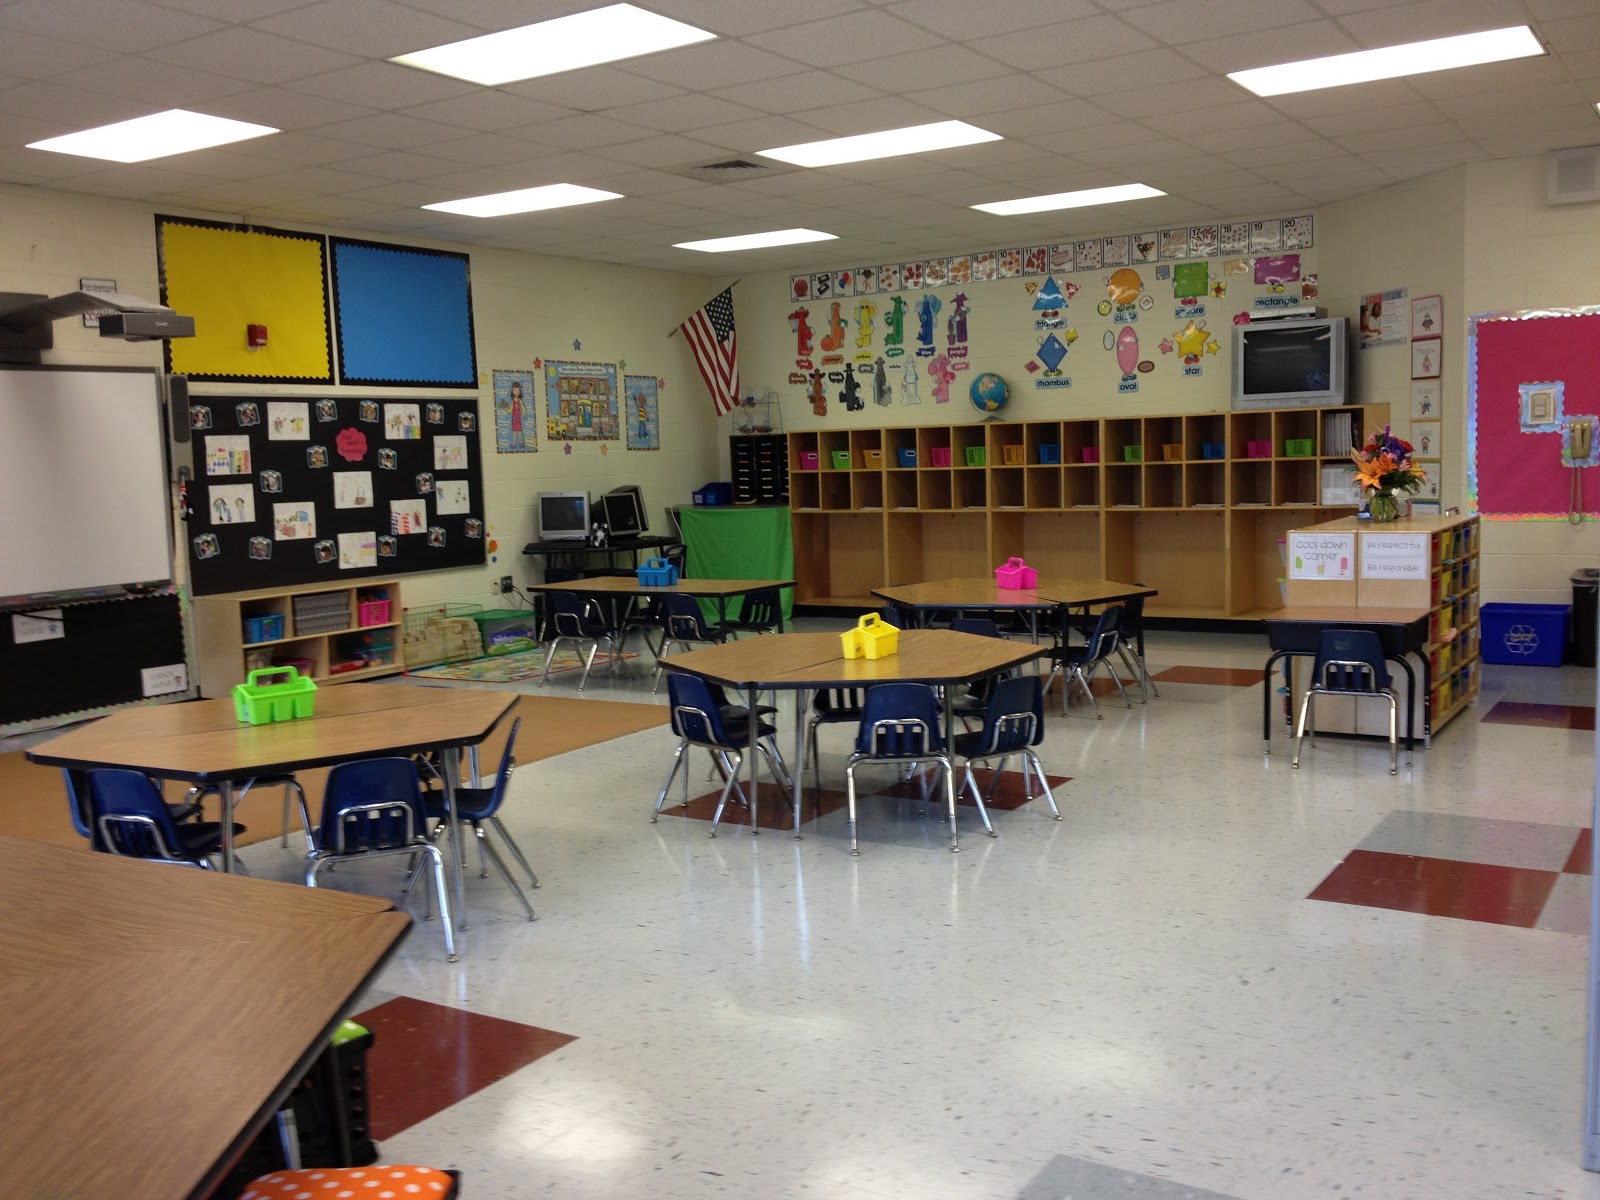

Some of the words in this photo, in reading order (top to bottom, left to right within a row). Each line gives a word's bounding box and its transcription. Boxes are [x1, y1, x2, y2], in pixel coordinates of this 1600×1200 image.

[1254, 222, 1263, 231] 19
[1285, 219, 1295, 228] 20
[1192, 228, 1201, 236] 17
[1223, 225, 1232, 233] 18
[1133, 235, 1142, 243] 15
[1162, 231, 1171, 239] 16
[1105, 238, 1113, 246] 14
[999, 250, 1007, 258] 10
[1255, 296, 1299, 306] rectangle
[1175, 307, 1204, 318] square
[1184, 367, 1201, 375] star
[1037, 379, 1070, 388] rhombus
[1120, 383, 1137, 391] oval
[1296, 540, 1318, 550] cool
[1320, 539, 1348, 549] down
[1304, 552, 1340, 561] corner
